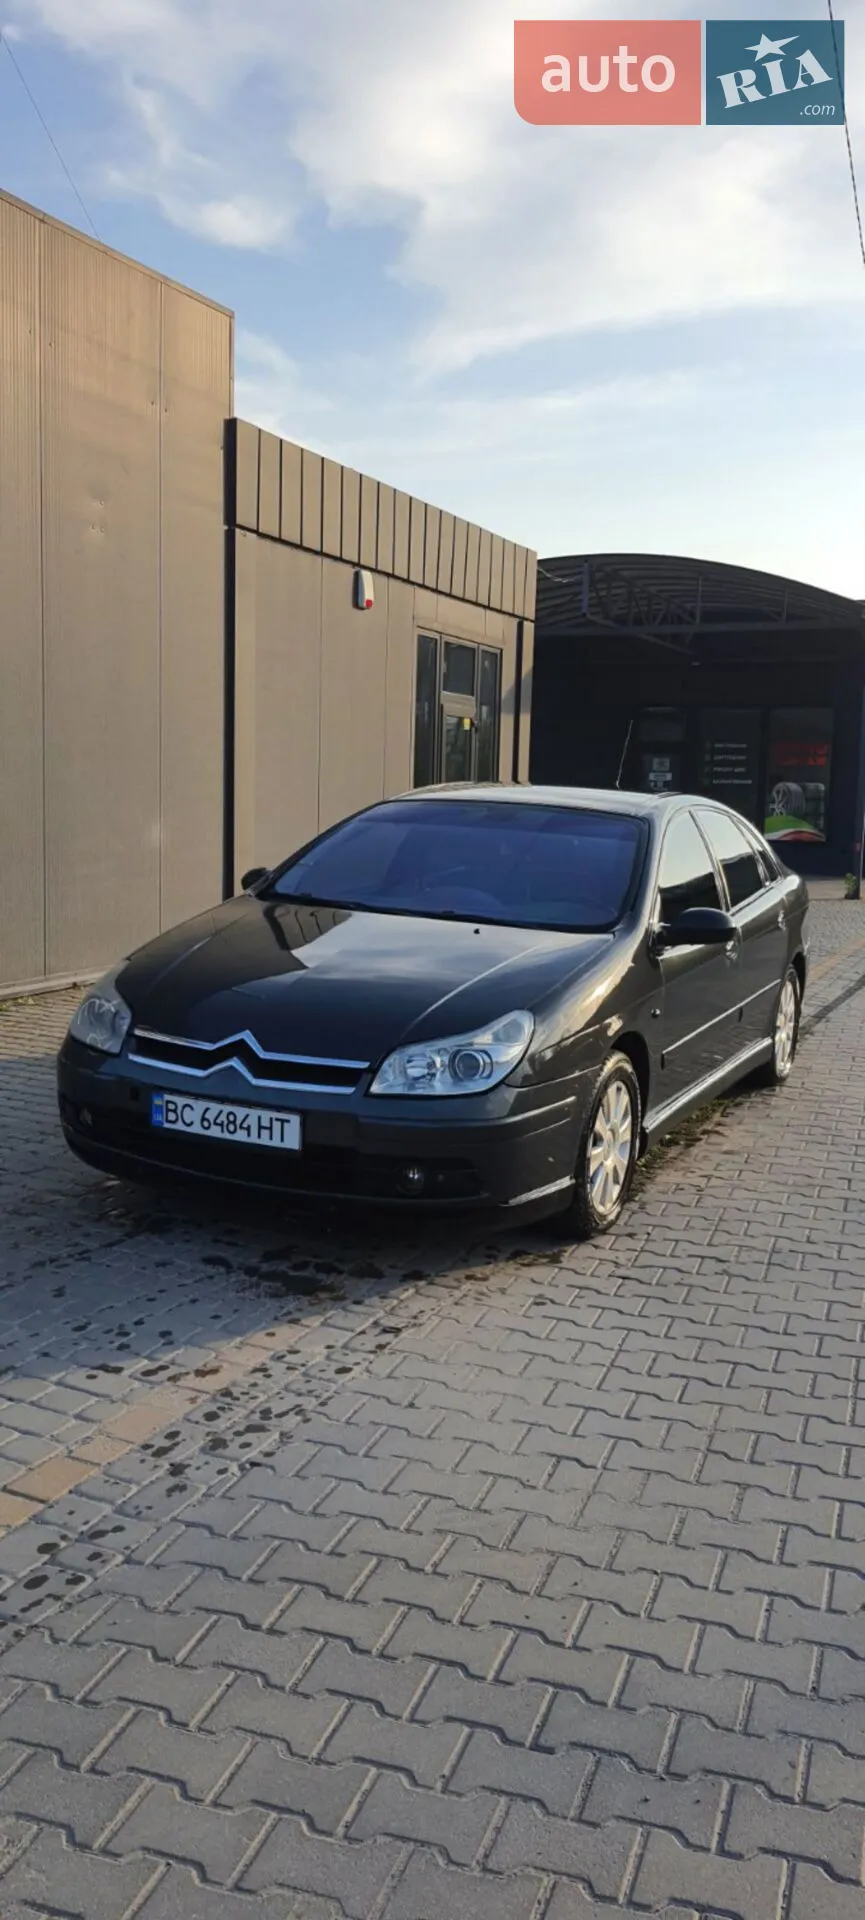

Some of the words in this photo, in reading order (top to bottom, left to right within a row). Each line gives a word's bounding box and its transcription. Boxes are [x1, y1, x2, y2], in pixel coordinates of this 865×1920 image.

[165, 1100, 195, 1128] BC
[201, 1107, 251, 1138] 6484
[257, 1115, 291, 1143] HT
